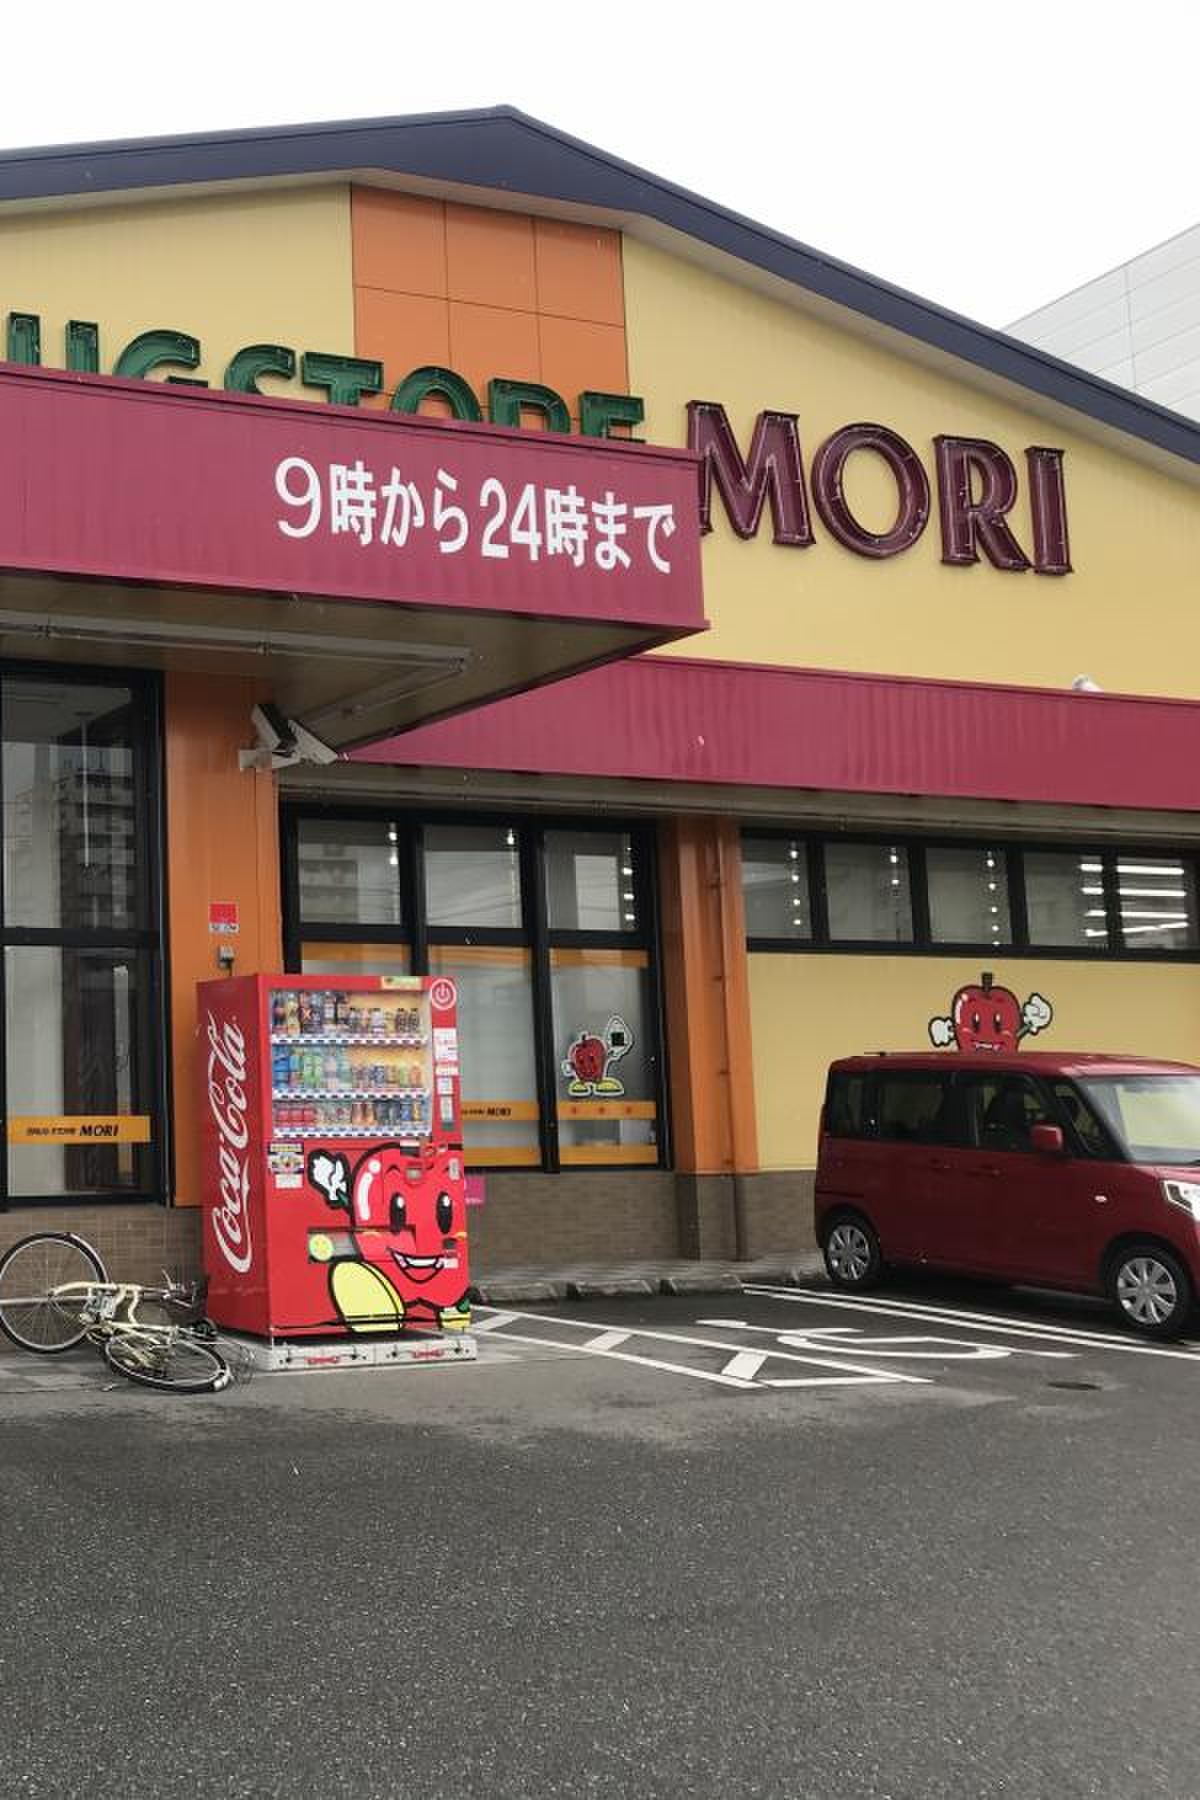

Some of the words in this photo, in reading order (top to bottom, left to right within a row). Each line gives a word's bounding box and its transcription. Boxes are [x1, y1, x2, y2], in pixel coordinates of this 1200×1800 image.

[274, 456, 676, 574] 9時から24時まで
[686, 399, 1073, 575] MORI
[79, 1124, 119, 1137] MORI
